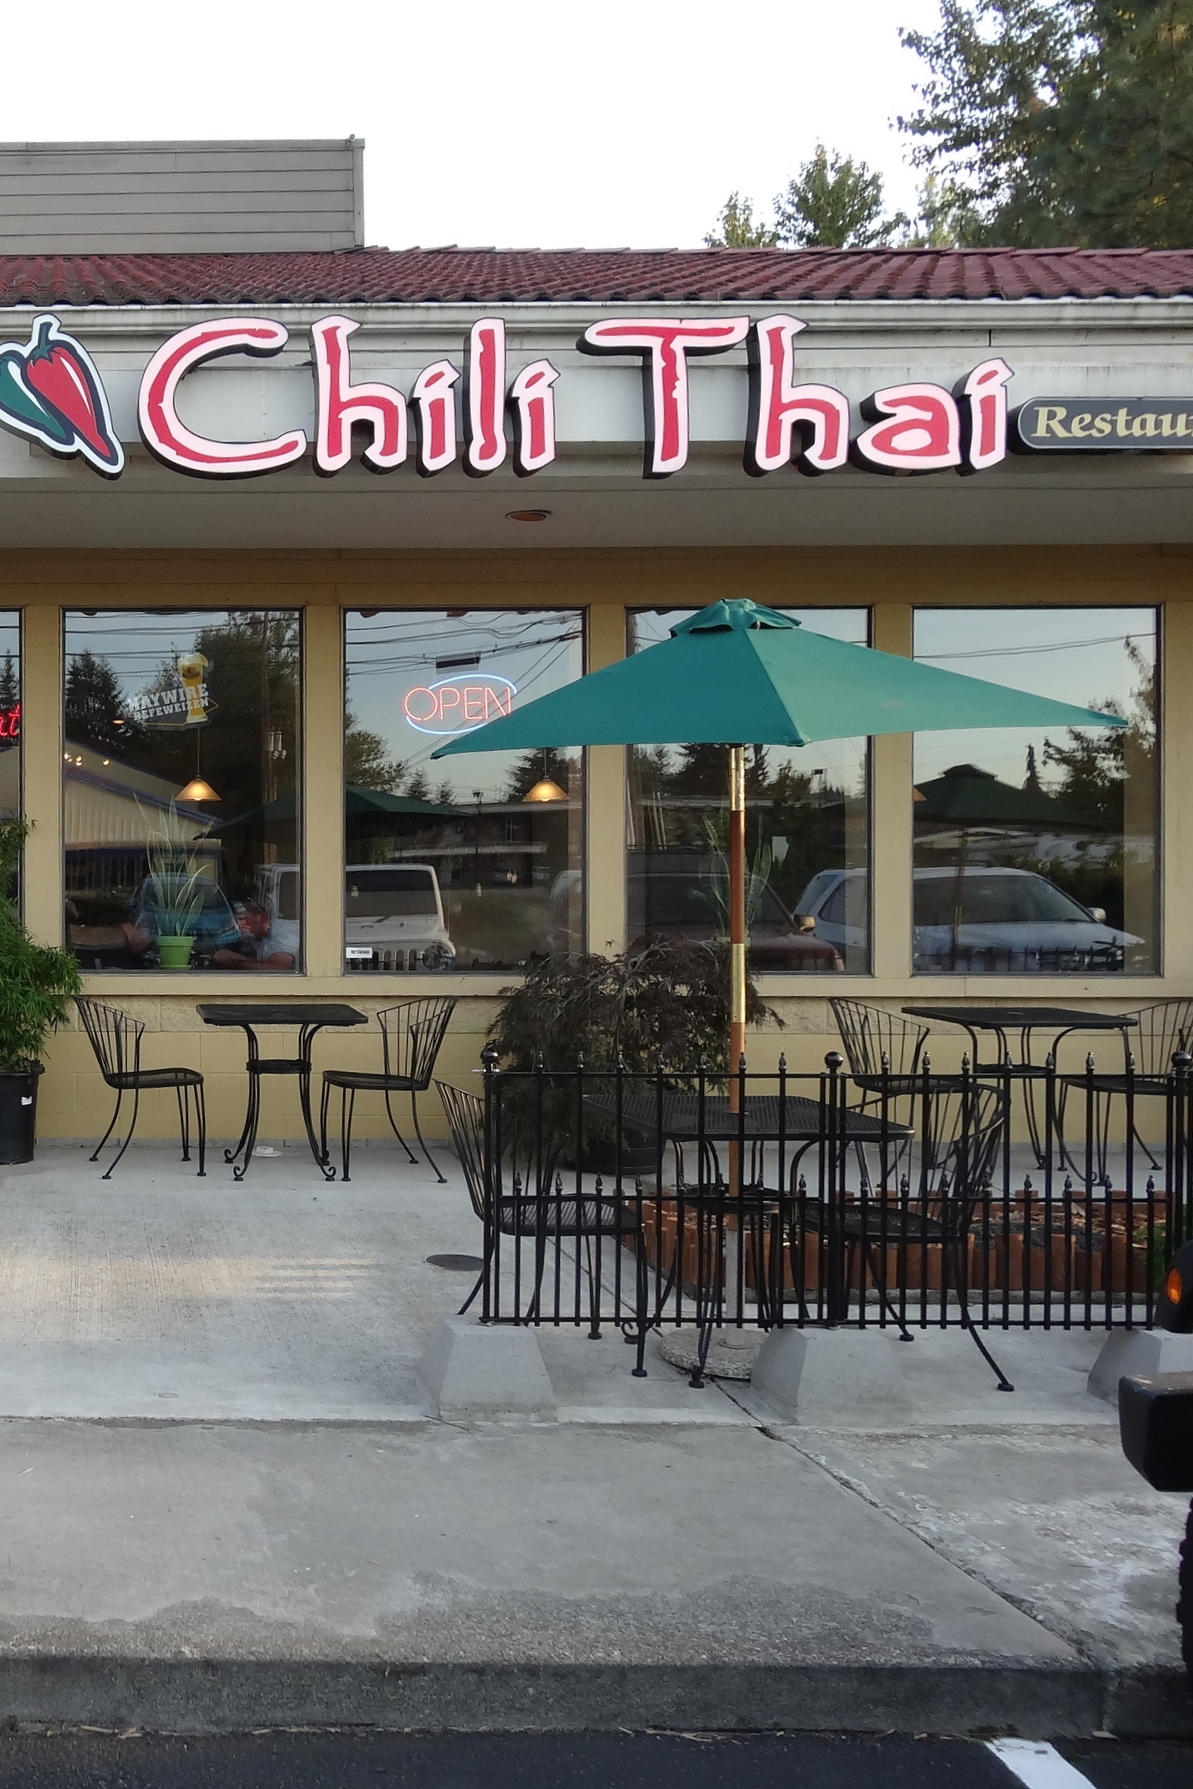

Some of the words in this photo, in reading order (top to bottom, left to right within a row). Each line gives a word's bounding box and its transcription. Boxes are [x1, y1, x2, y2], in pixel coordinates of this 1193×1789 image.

[138, 314, 561, 477] Chili
[579, 313, 1016, 477] Thai
[1030, 406, 1193, 438] Restau
[402, 686, 513, 722] OPEN
